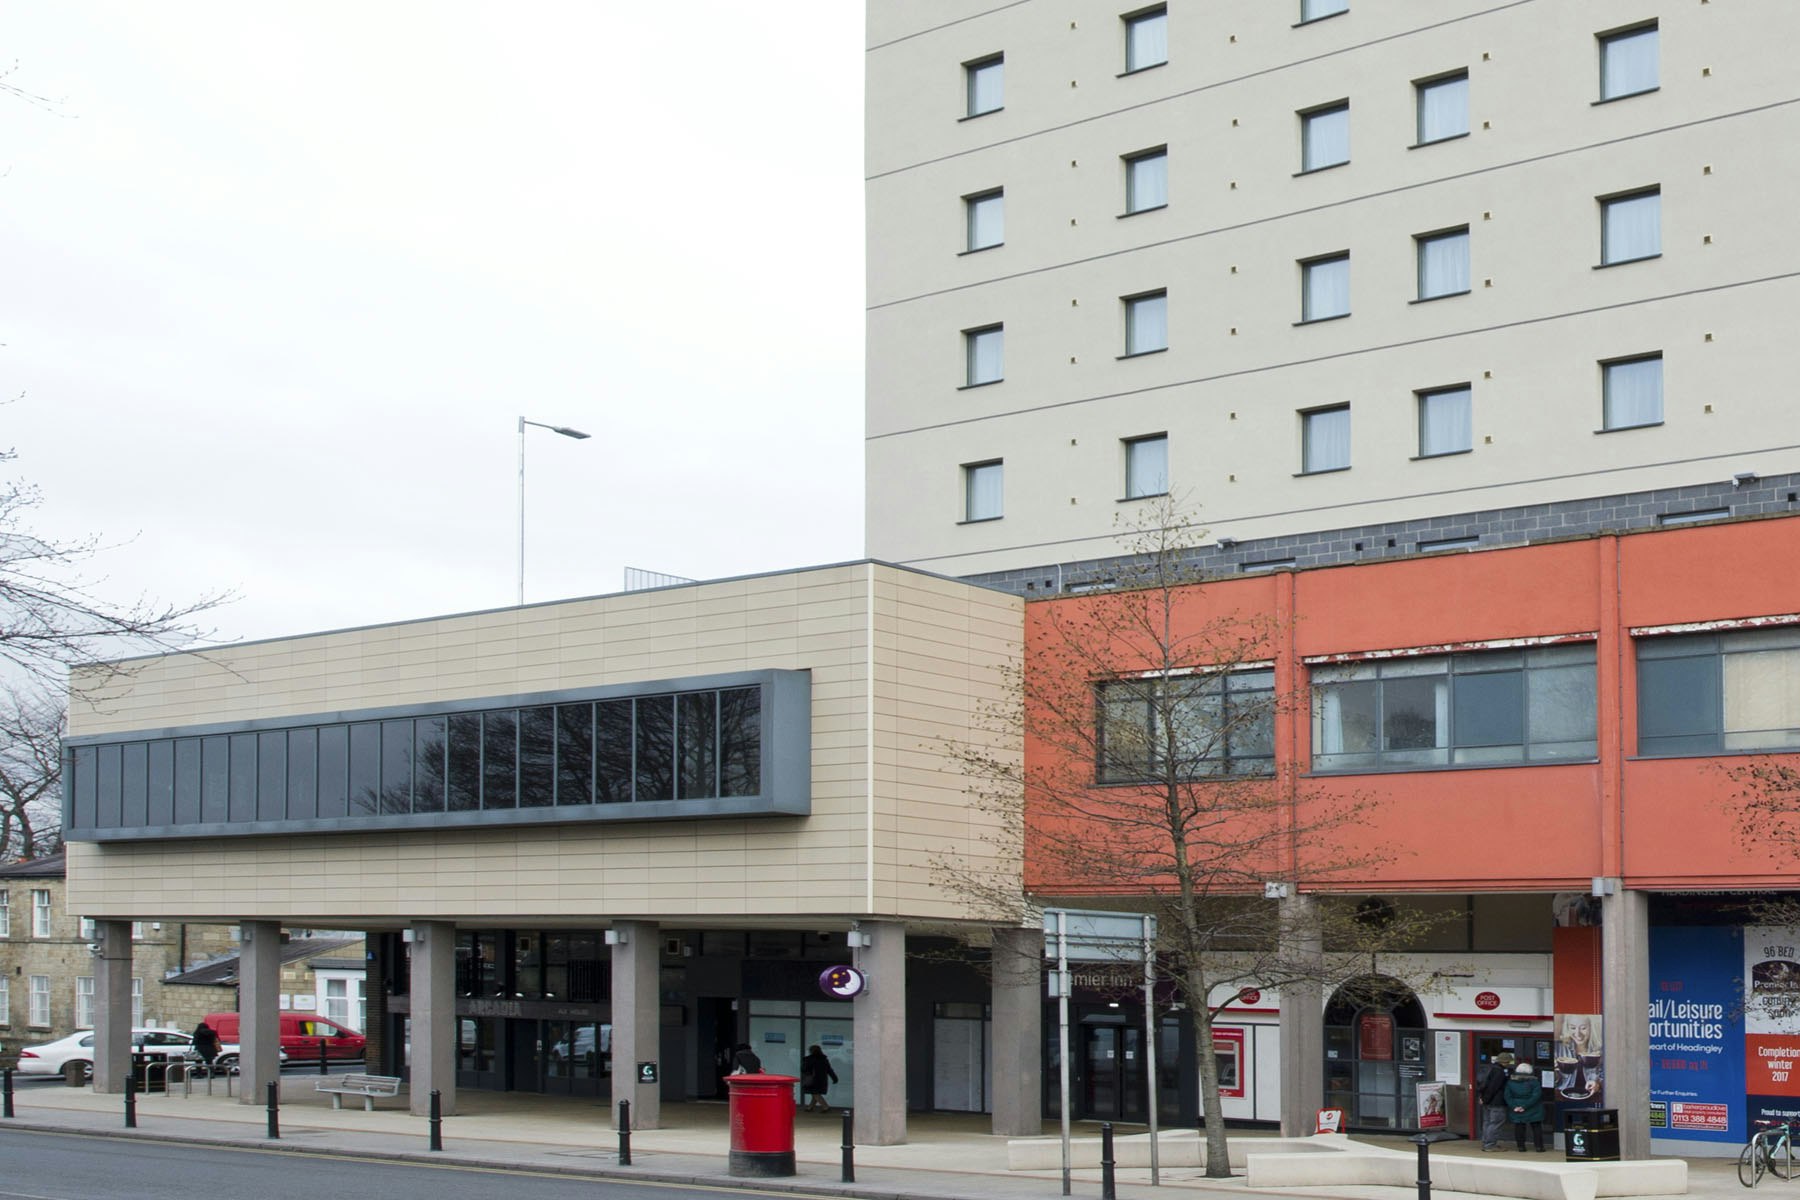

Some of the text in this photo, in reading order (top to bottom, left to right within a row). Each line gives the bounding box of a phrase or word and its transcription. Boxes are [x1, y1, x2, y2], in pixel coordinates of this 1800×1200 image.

[1763, 946, 1795, 958] 96 BED
[1649, 999, 1723, 1019] ail/Leisure
[1649, 1020, 1723, 1039] ortunities
[1649, 1043, 1723, 1054] eart of Headingley
[1767, 1059, 1792, 1069] winter
[1772, 1071, 1789, 1082] 2017
[1761, 1108, 1775, 1116] Proud
[1782, 1109, 1800, 1118] support
[1673, 1114, 1726, 1124] 0113 388 4848
